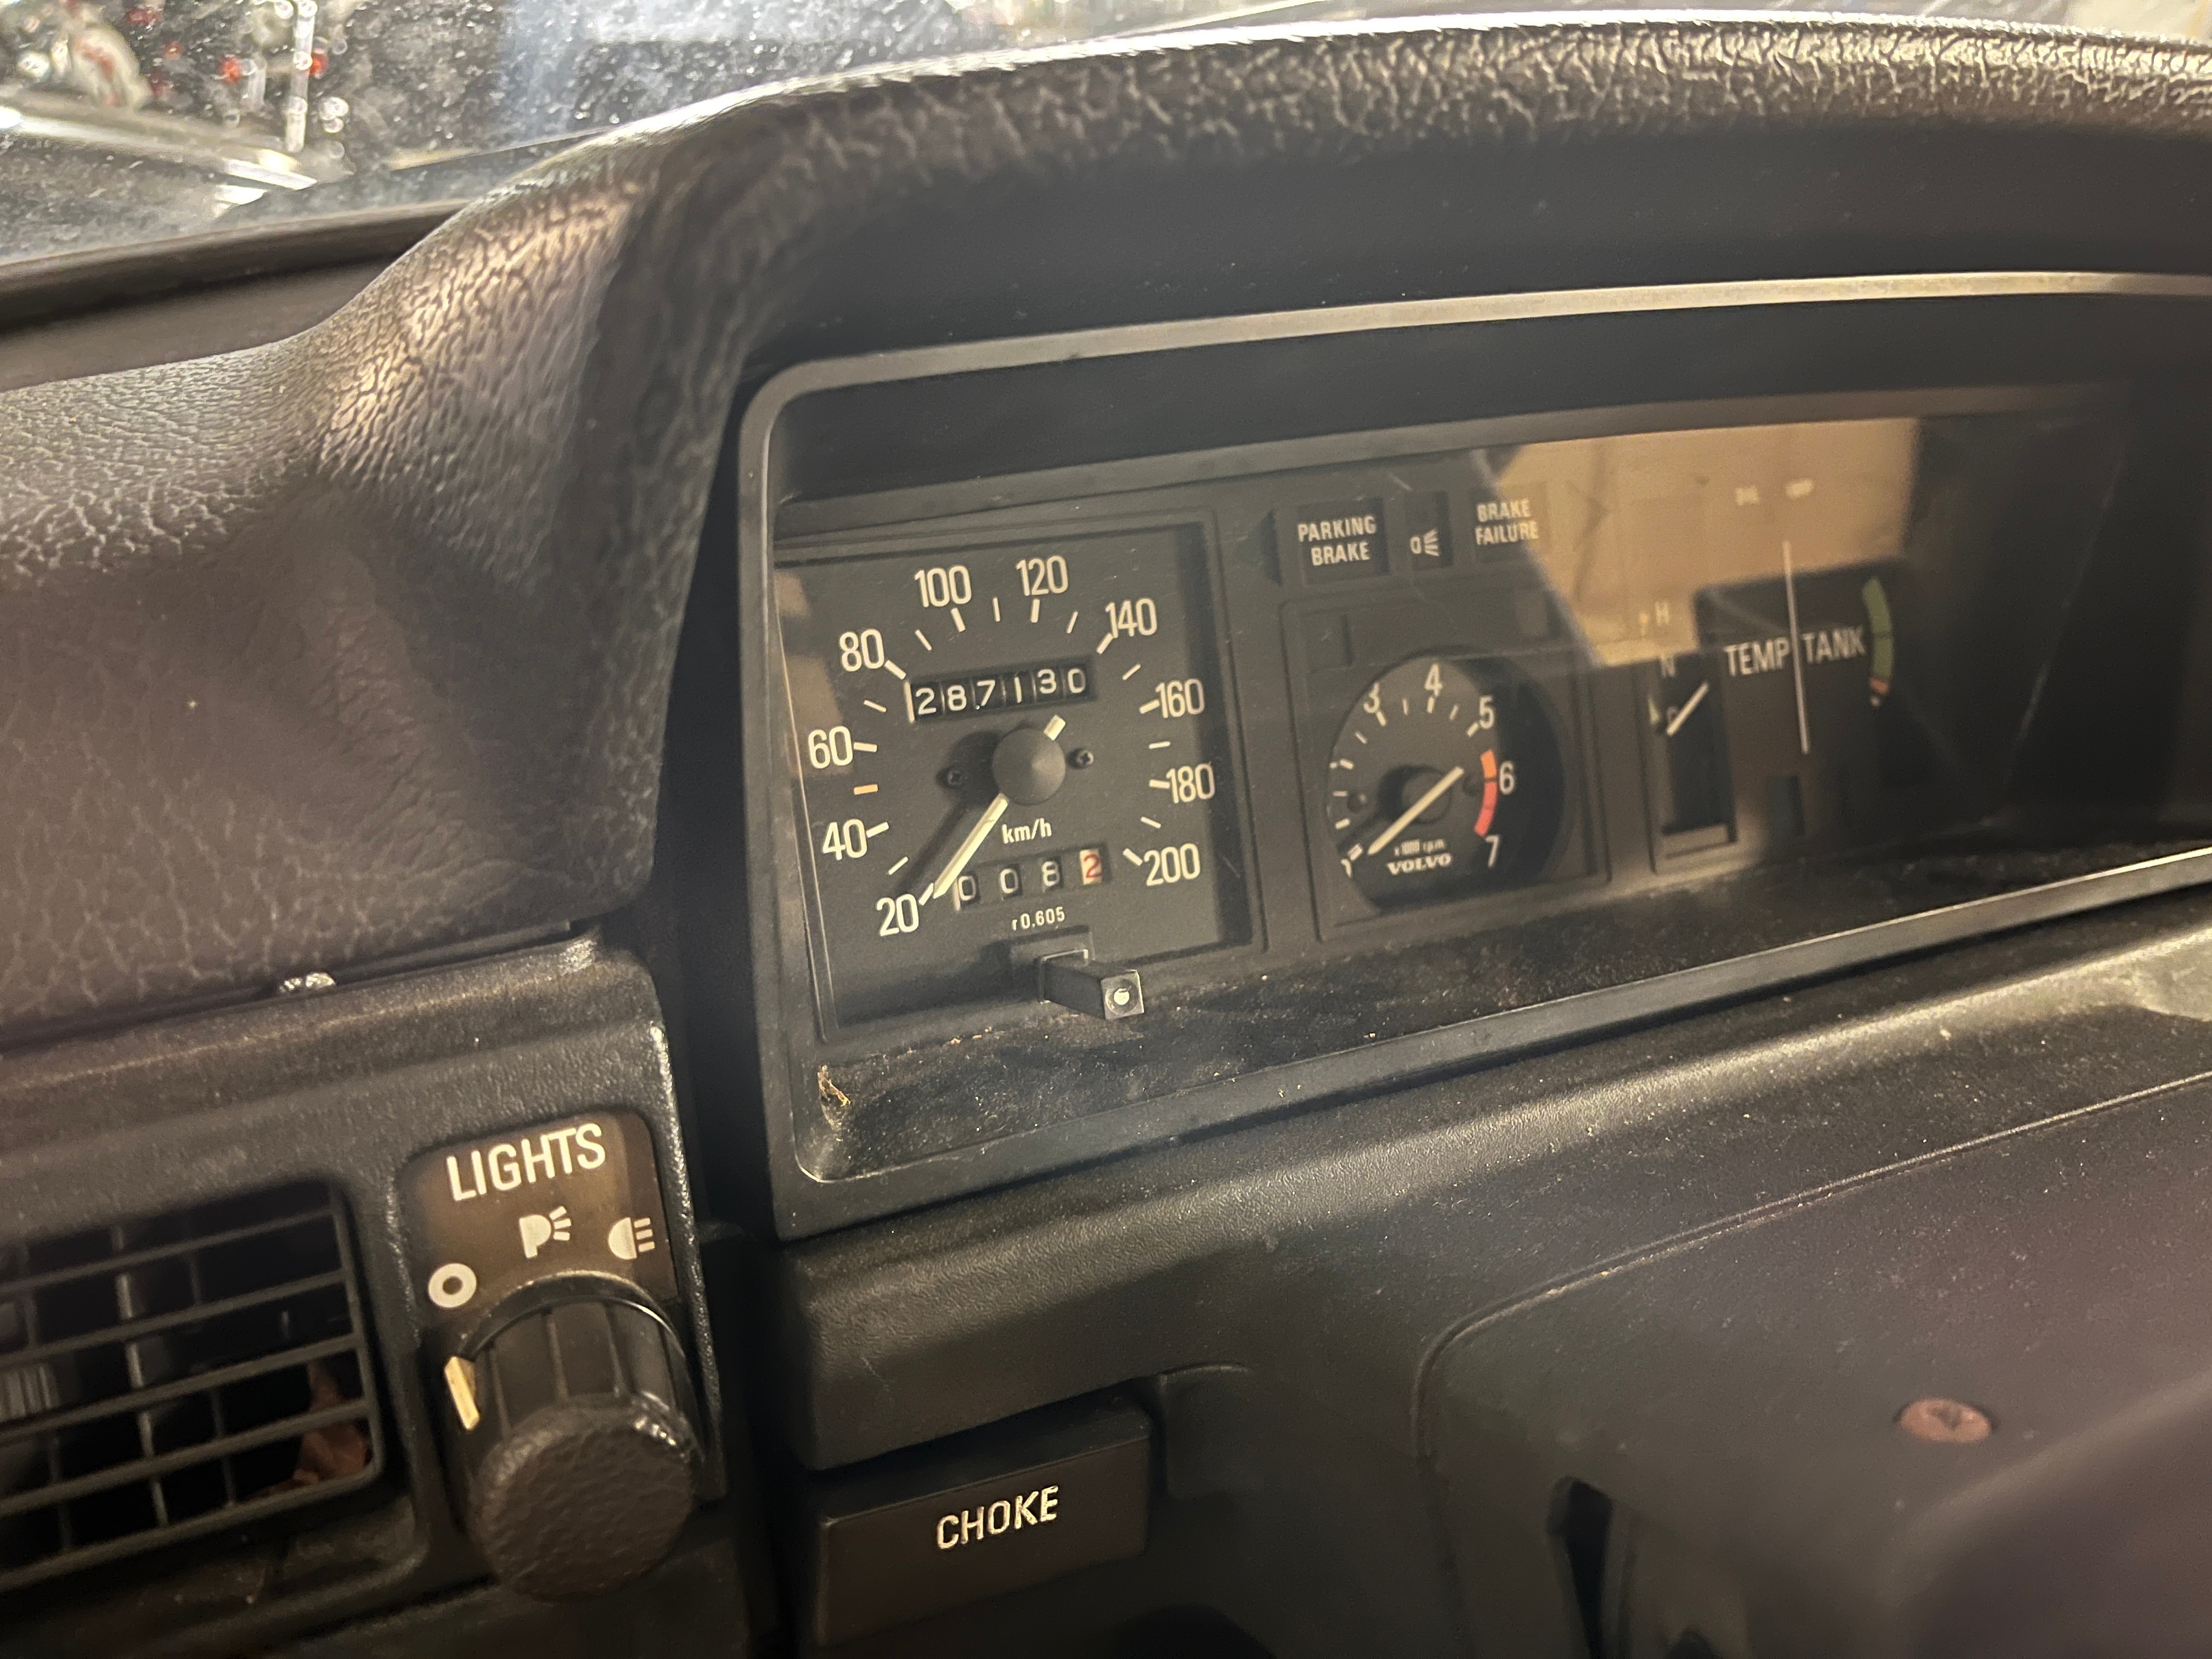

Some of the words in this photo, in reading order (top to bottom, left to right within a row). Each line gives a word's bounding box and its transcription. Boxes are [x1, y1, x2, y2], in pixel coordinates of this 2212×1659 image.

[1298, 516, 1376, 543] PARKING
[1477, 500, 1531, 522] BRAKE
[1475, 522, 1539, 545] FAILURE
[1312, 543, 1370, 566] BRAKE
[915, 566, 972, 607] 100
[1016, 556, 1068, 595] 120
[1105, 599, 1157, 637] 140
[839, 629, 884, 672] 80
[1723, 637, 1790, 677] TEMP
[1802, 627, 1865, 664] TANK
[1155, 679, 1204, 718] 160
[1425, 664, 1443, 697] 4
[1481, 696, 1495, 729] 5
[809, 726, 853, 769] 60
[1166, 764, 1215, 803] 180
[1499, 761, 1515, 795] 6
[823, 819, 867, 861] 40
[1002, 817, 1052, 844] km/h
[1144, 844, 1200, 886] 200
[1386, 853, 1452, 875] VOLVO
[1485, 836, 1501, 868] 7
[877, 894, 919, 936] 20
[447, 1123, 606, 1201] LIGHTS
[936, 1485, 1059, 1549] CHOKE
